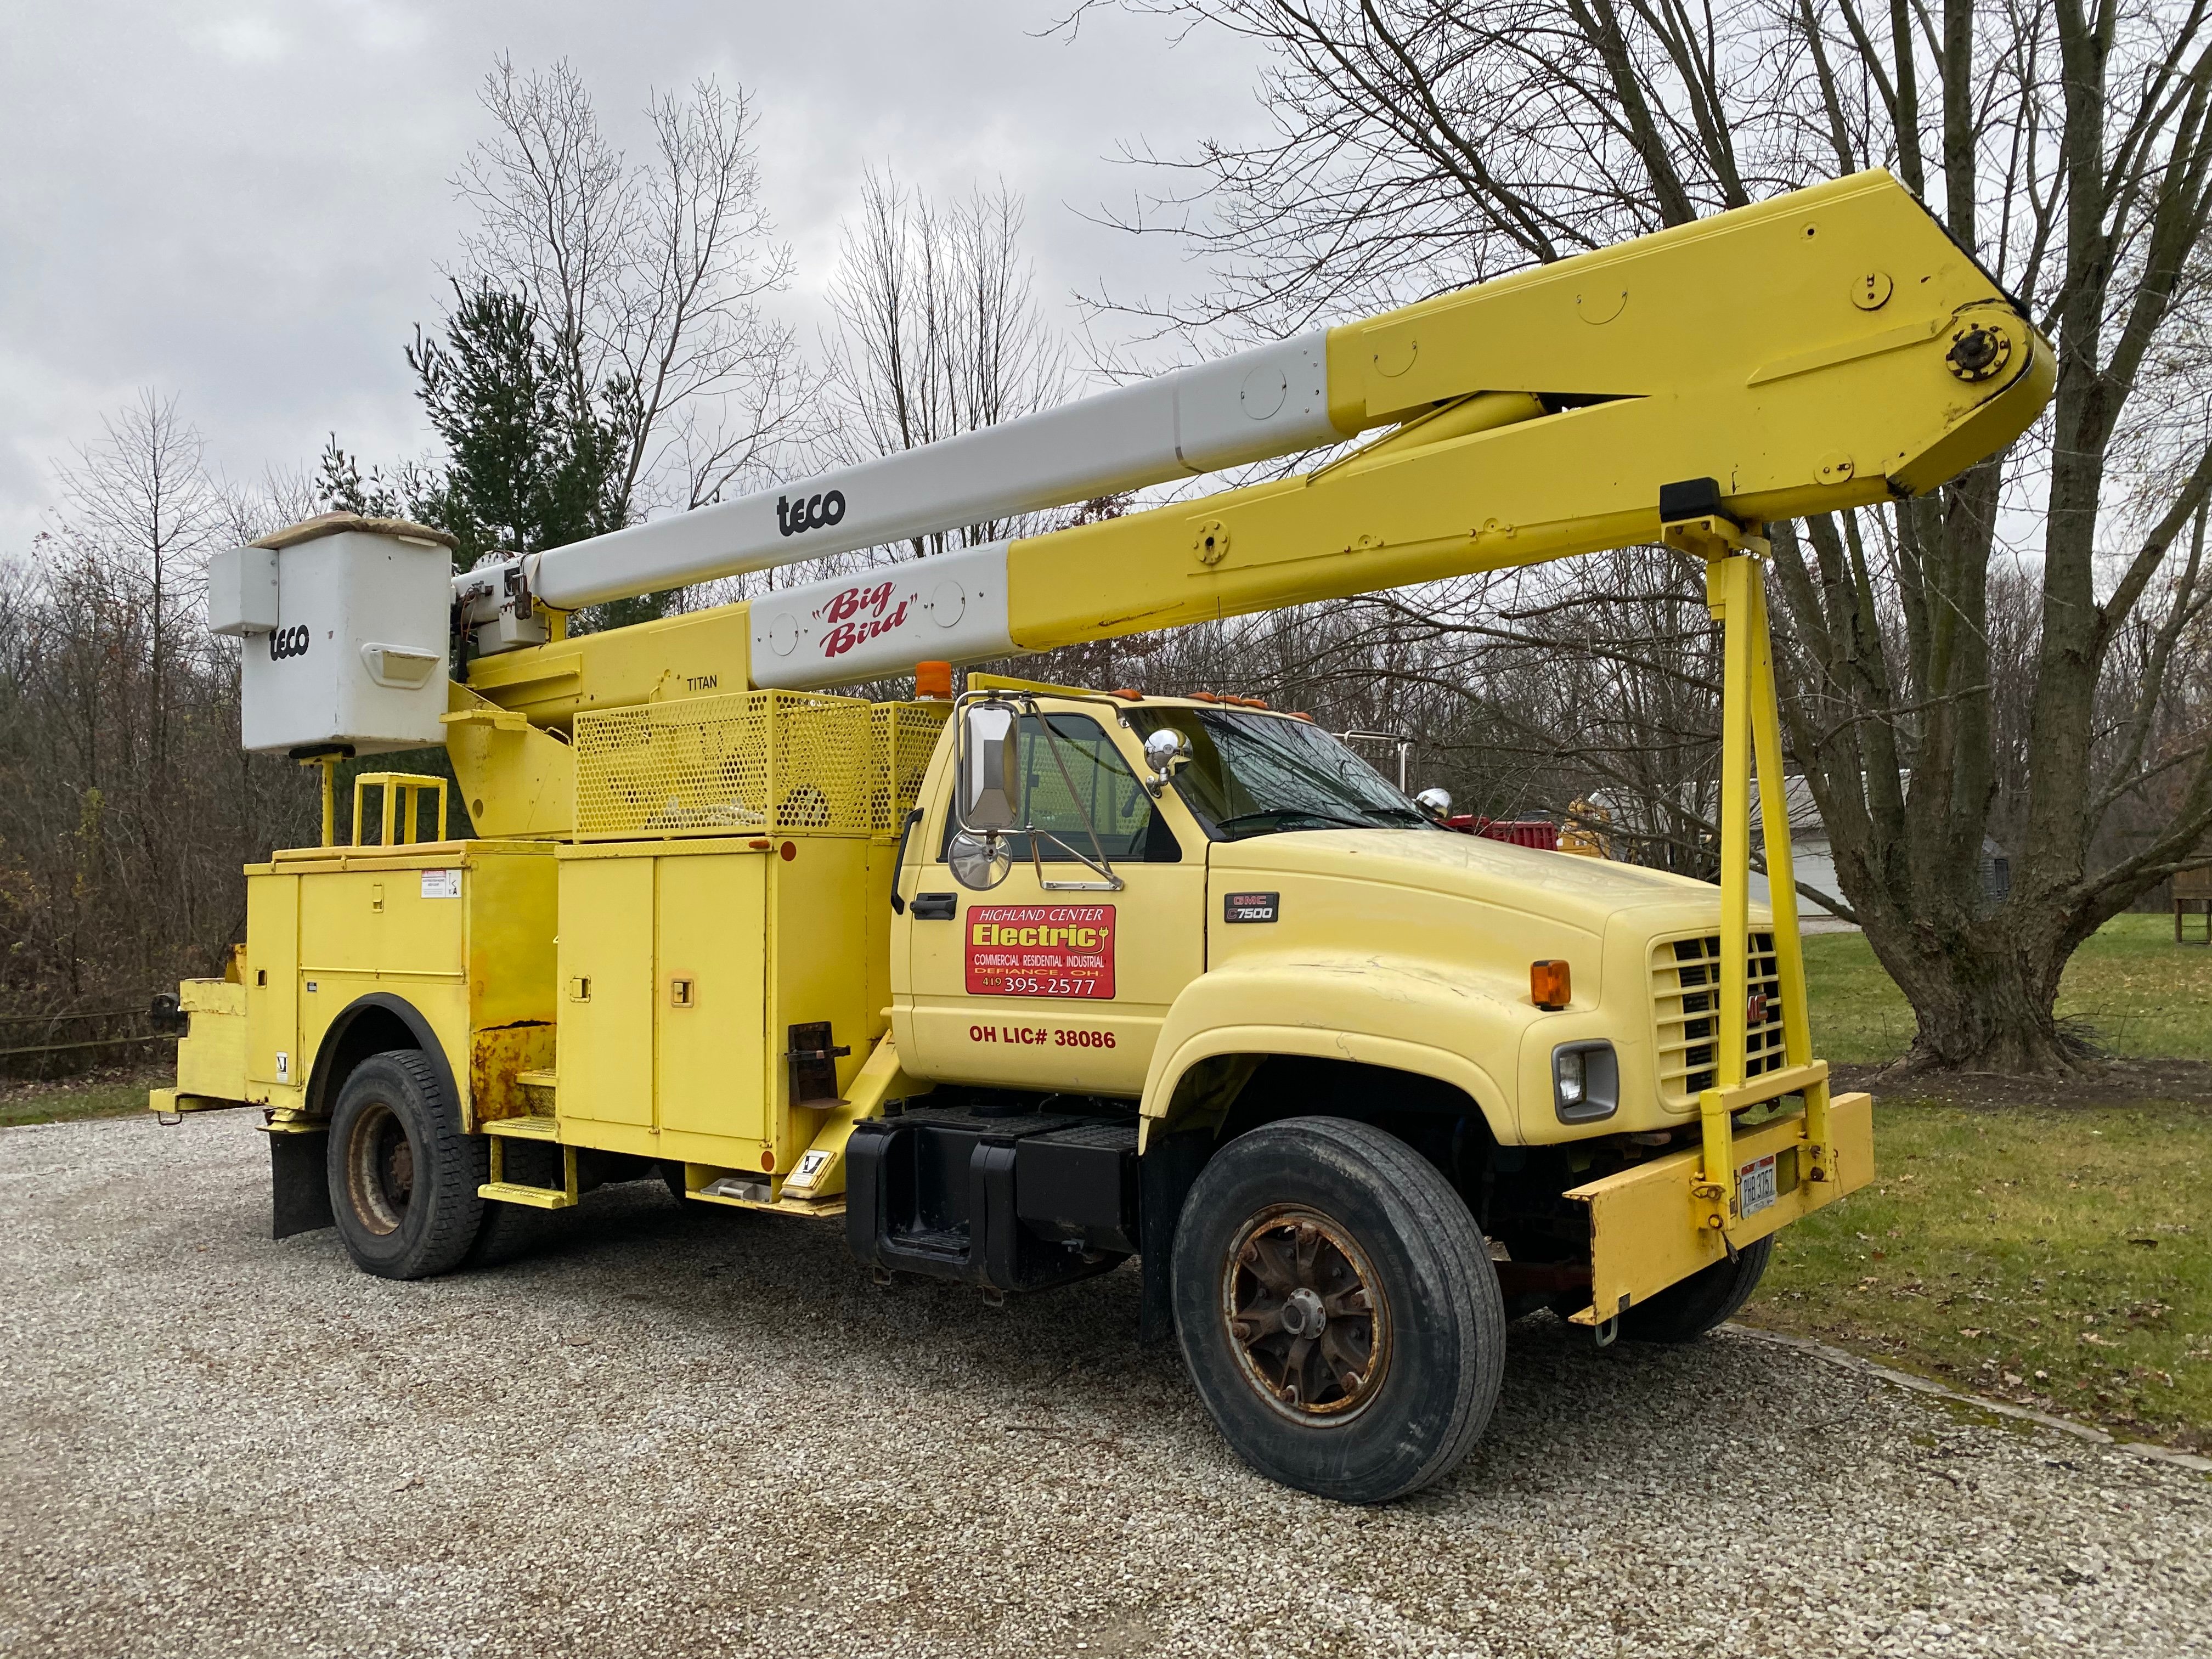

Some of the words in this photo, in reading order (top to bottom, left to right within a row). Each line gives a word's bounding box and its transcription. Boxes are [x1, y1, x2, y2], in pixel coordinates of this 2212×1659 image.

[776, 490, 845, 537] teco
[686, 674, 717, 691] TITAN
[1233, 895, 1267, 905] GMC
[979, 909, 1045, 921] HIGHLAND
[1049, 909, 1103, 921] CENTER
[972, 923, 1096, 947] Electric
[974, 953, 1019, 967] COMMERCIAL
[1023, 955, 1063, 967] RESIDENTIAL
[1066, 956, 1104, 968] INDUSTRIAL
[982, 977, 1002, 986] 419
[1005, 977, 1096, 995] 395-2577
[969, 1025, 997, 1042] OH
[1003, 1027, 1048, 1045] LIC#
[1054, 1029, 1116, 1048] 38086
[1757, 1168, 1773, 1199] 3757
